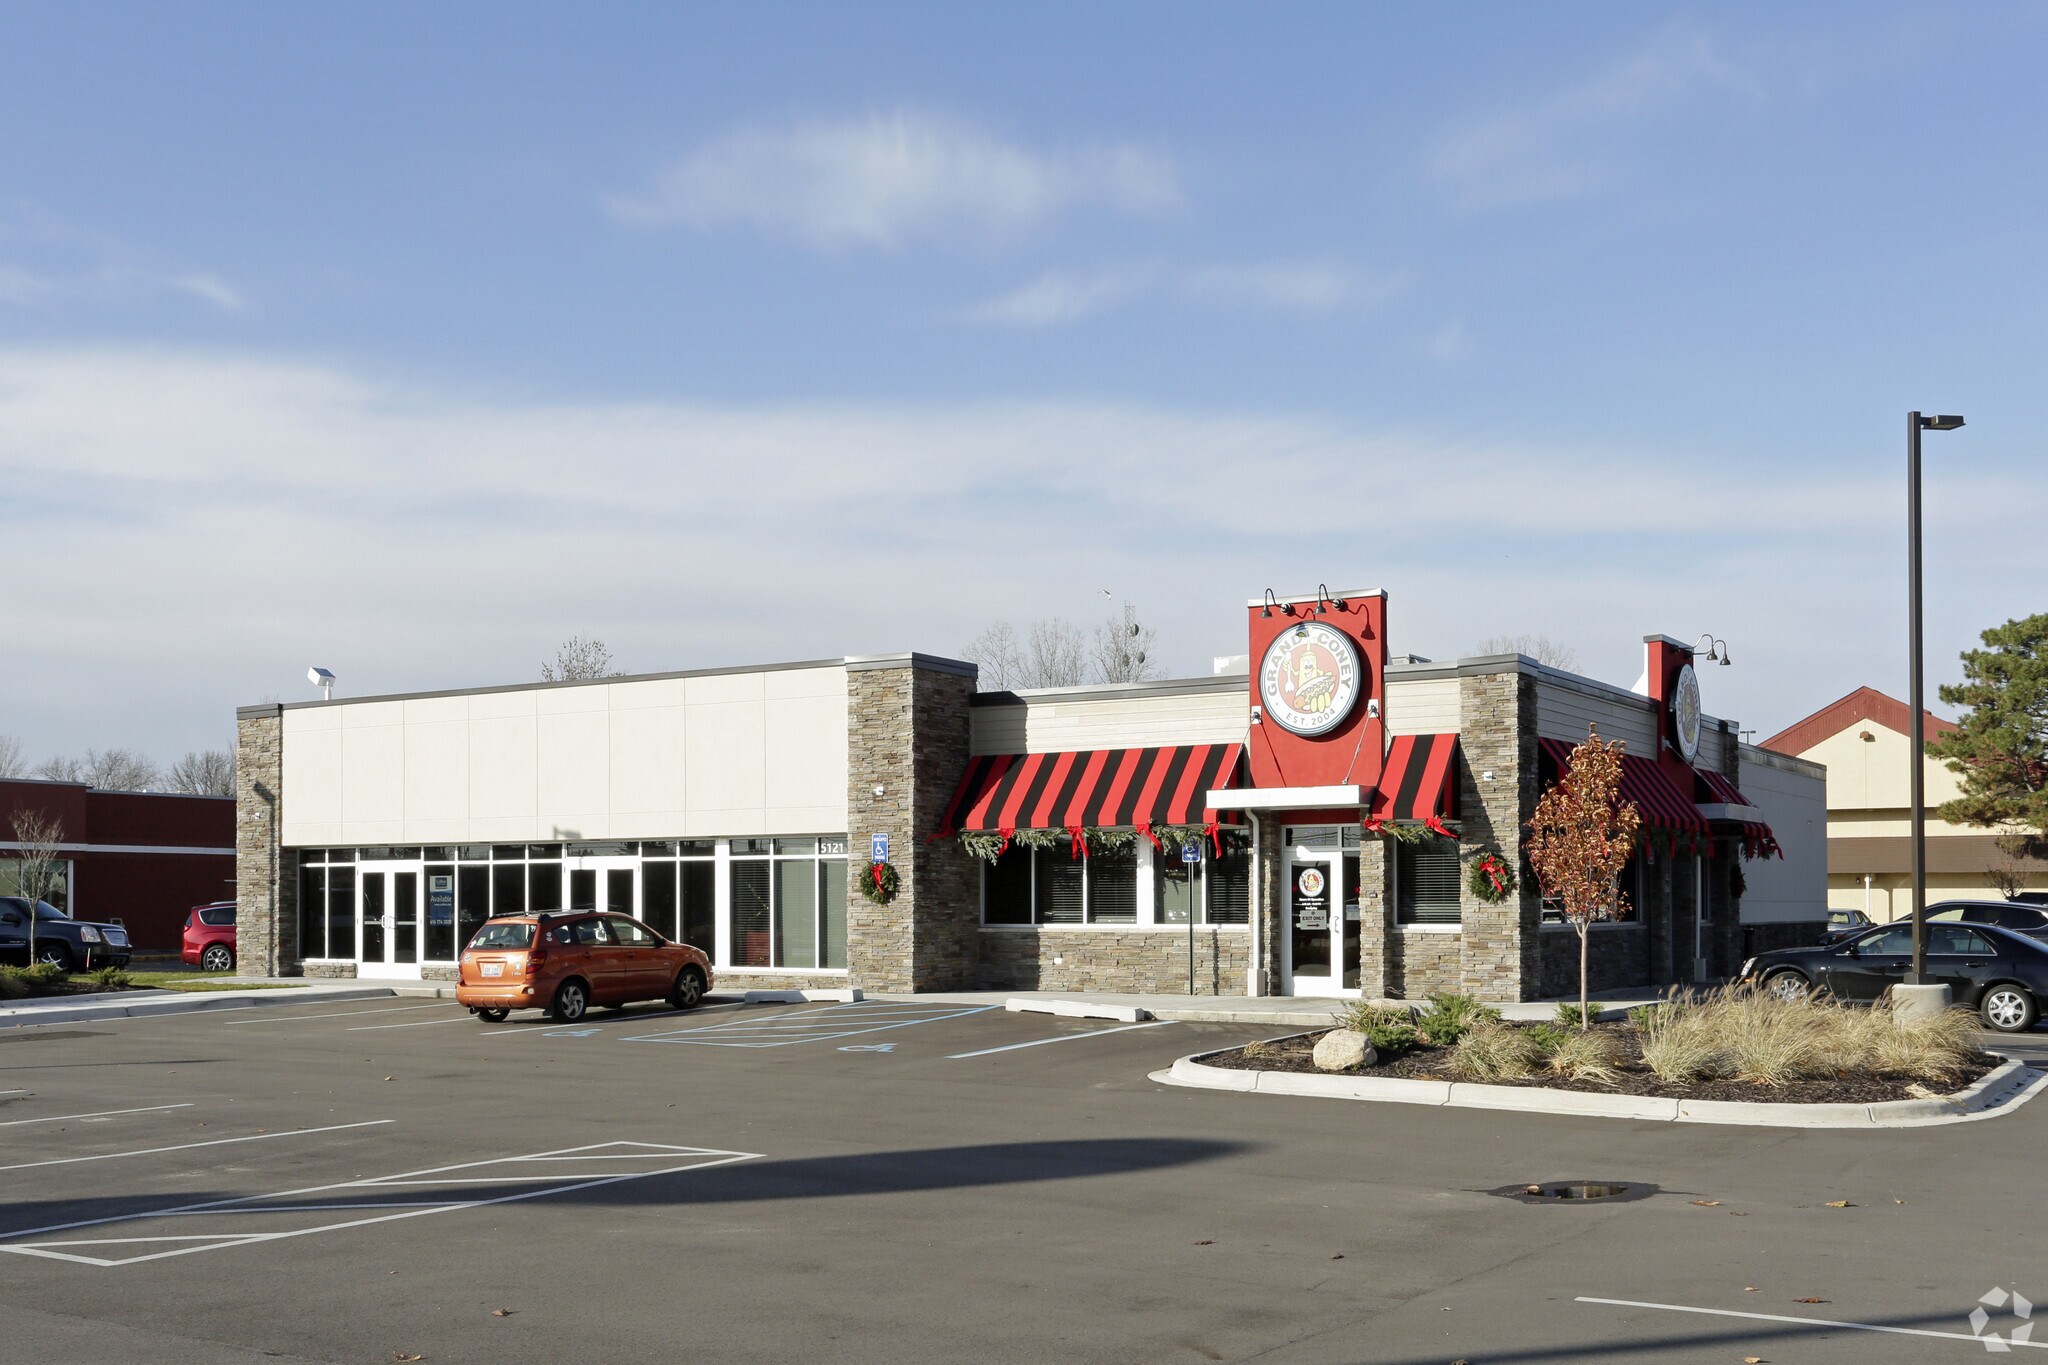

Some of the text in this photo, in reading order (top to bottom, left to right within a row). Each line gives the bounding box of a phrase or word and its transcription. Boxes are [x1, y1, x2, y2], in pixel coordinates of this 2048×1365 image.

[1267, 633, 1352, 697] GRAND CONEY
[1286, 708, 1336, 726] EST. 2004
[820, 842, 843, 853] 5121
